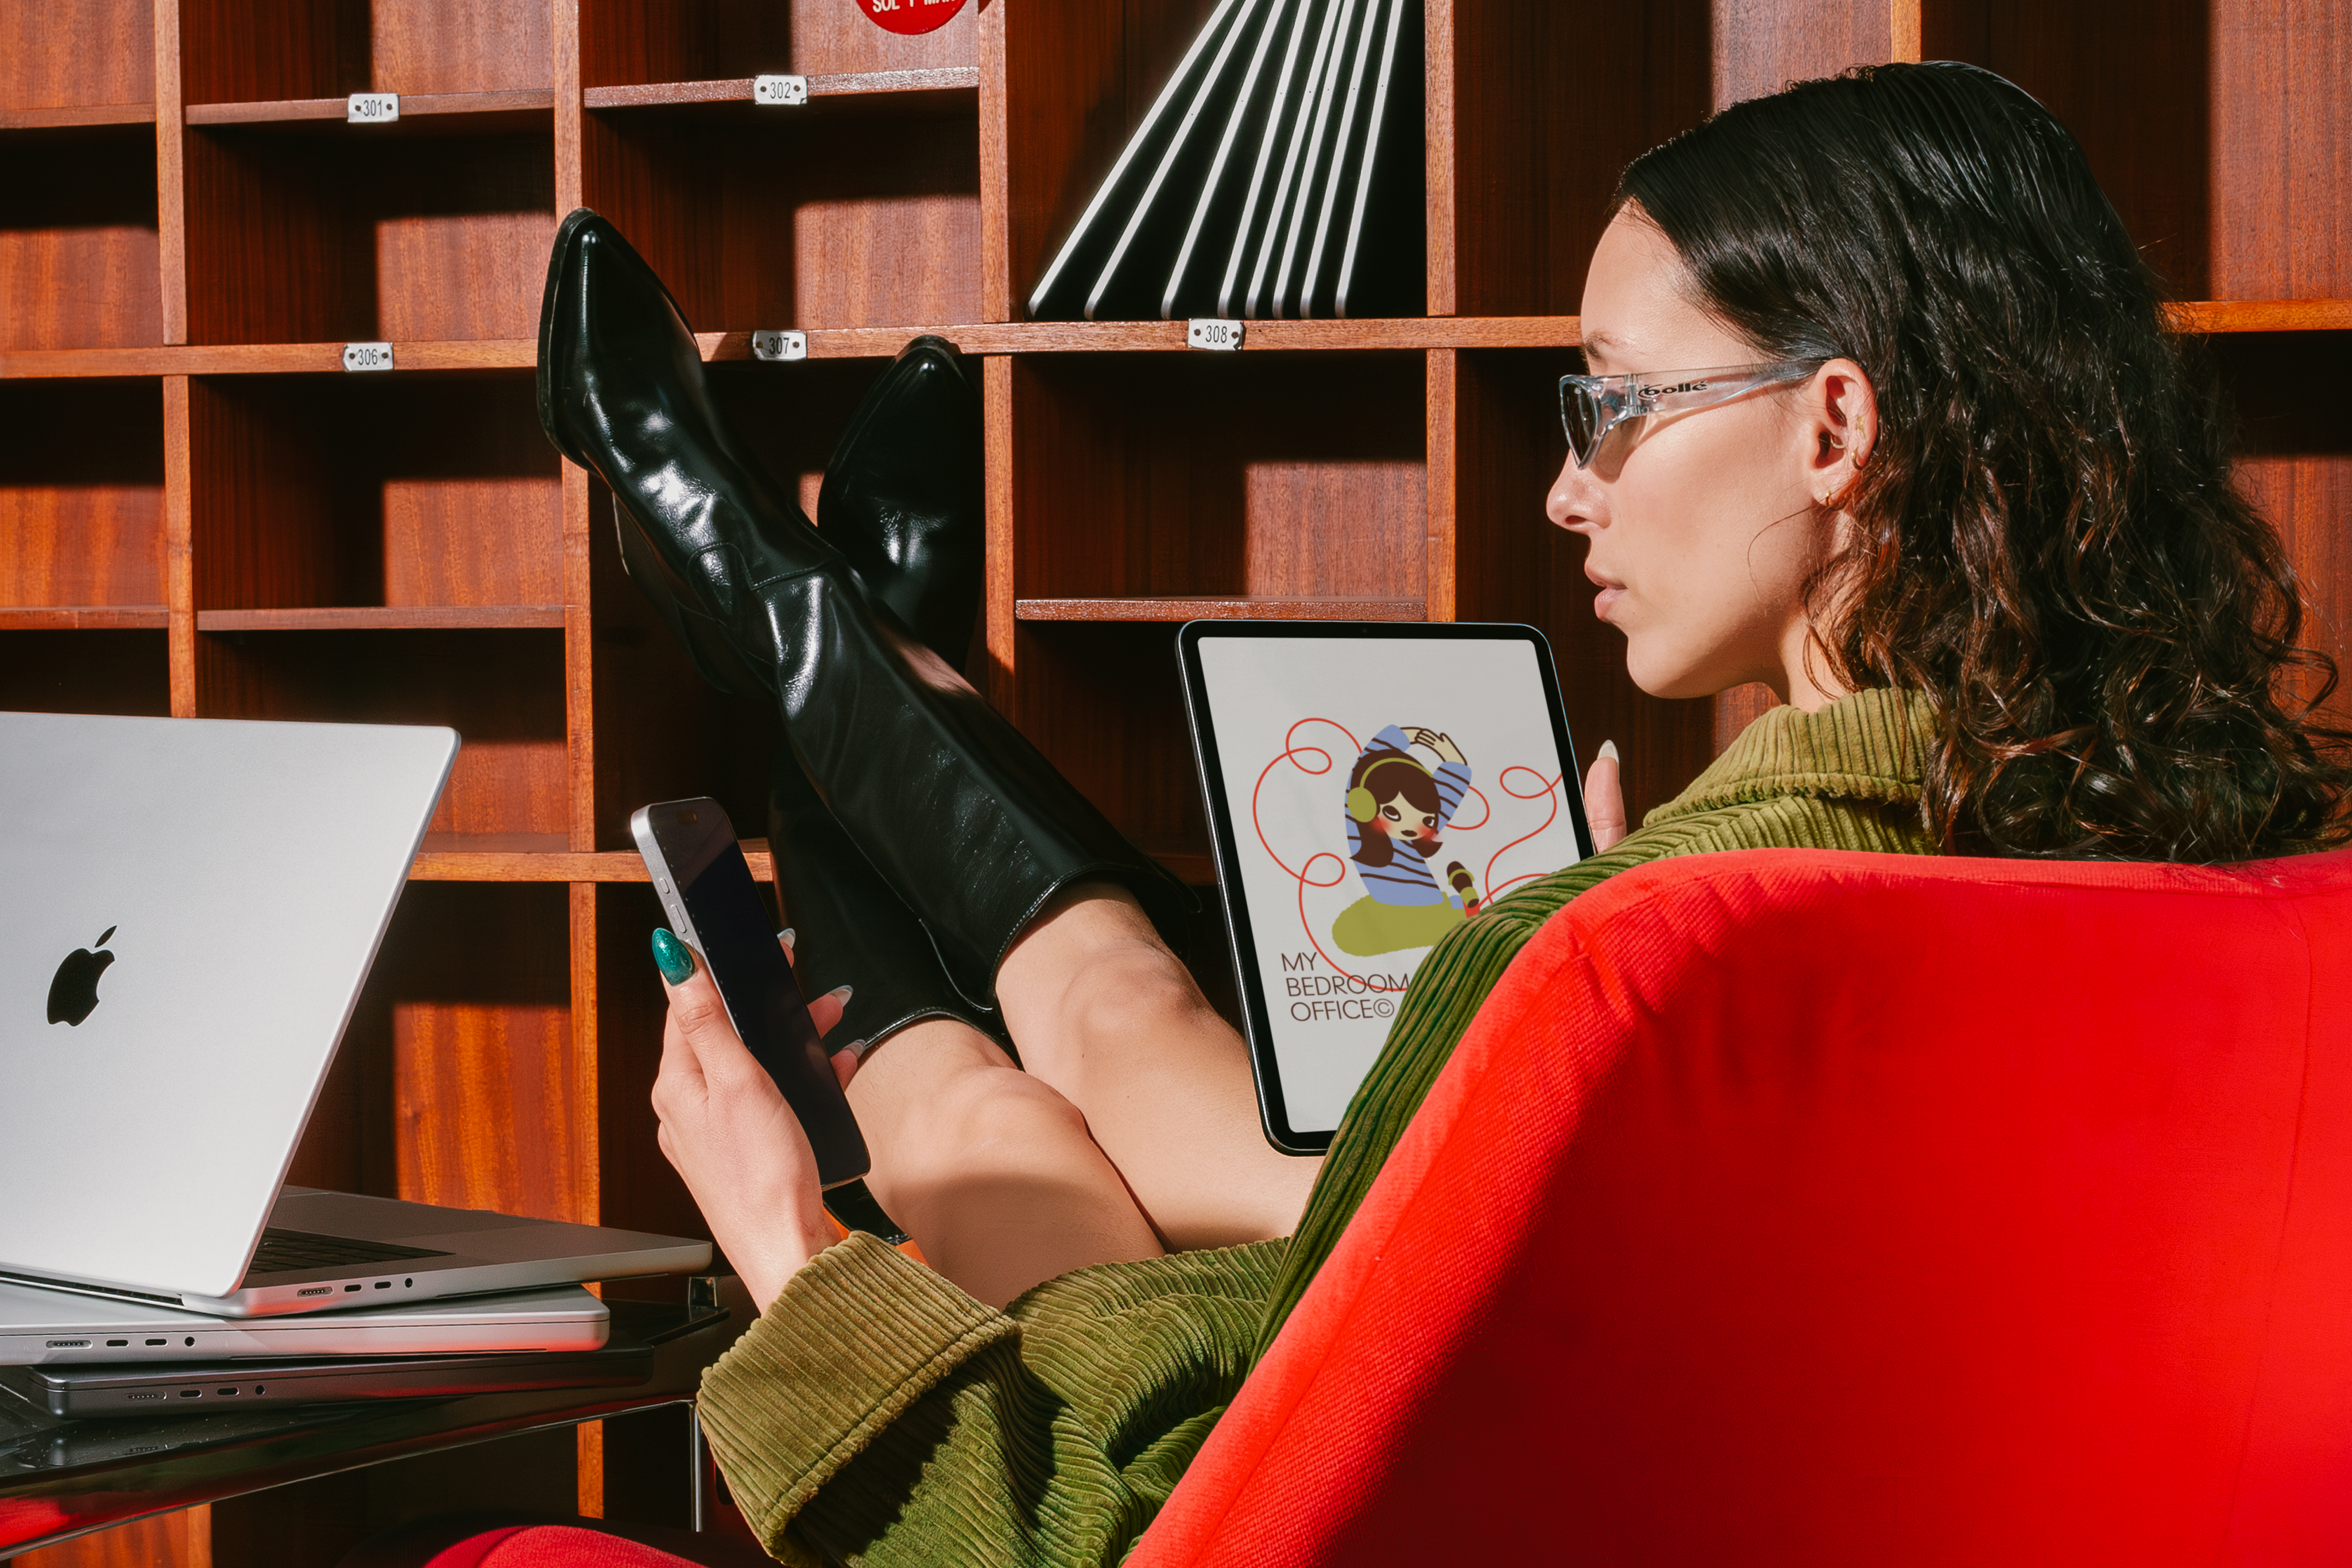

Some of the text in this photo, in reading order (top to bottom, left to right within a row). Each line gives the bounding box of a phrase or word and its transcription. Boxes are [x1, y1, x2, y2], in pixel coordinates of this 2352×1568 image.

[770, 82, 791, 99] 302
[363, 99, 382, 117] 301
[1205, 325, 1227, 343] 308
[769, 336, 790, 354] 307
[358, 349, 378, 365] 306
[1281, 951, 1317, 971] MY
[1286, 973, 1410, 997] BEDROOM
